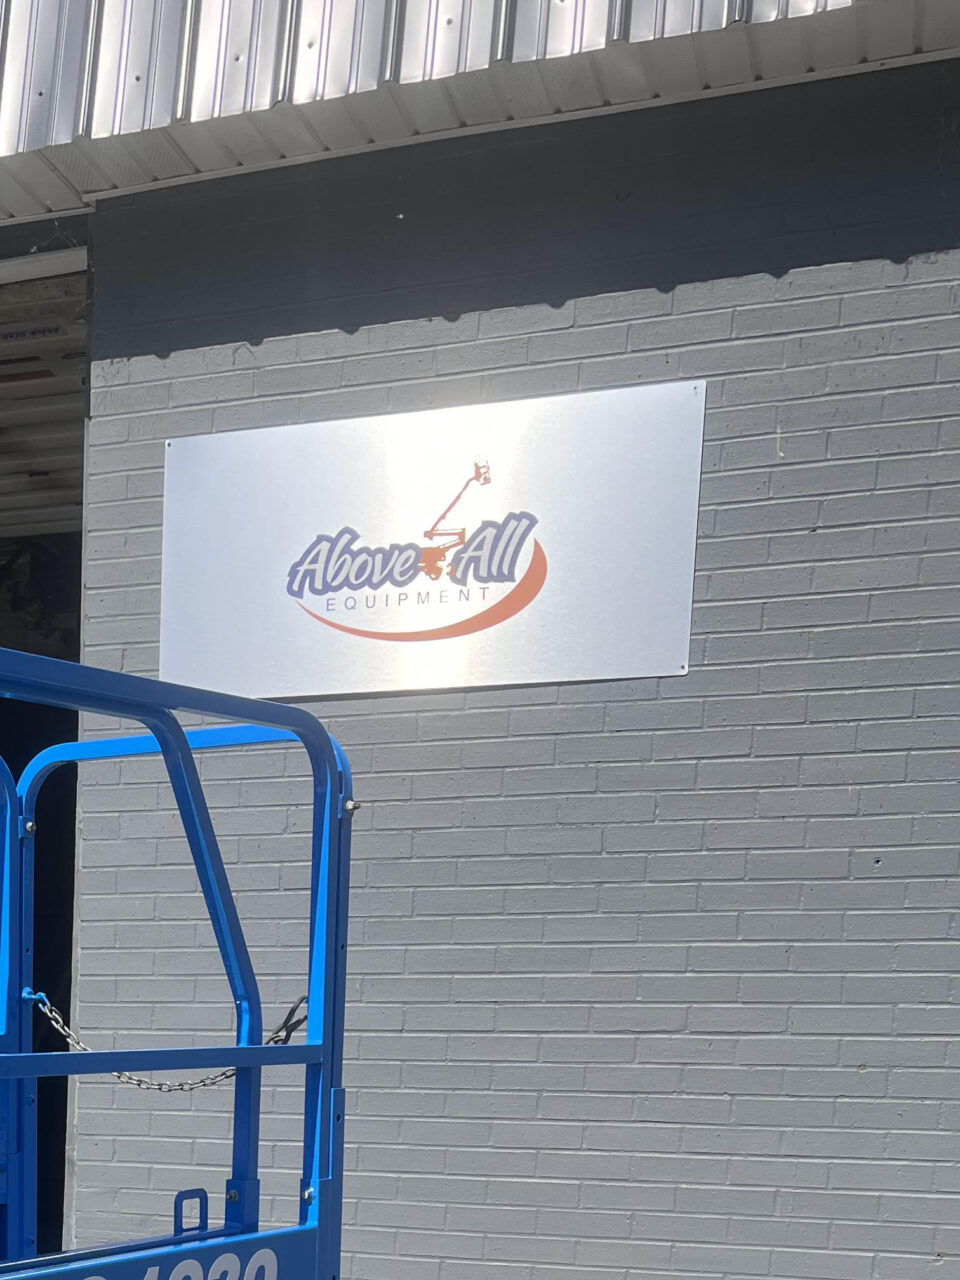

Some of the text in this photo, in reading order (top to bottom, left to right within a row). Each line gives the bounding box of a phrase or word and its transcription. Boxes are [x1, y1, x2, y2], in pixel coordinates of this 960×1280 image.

[289, 513, 537, 596] Above All
[326, 585, 492, 612] EQUIPMENT
